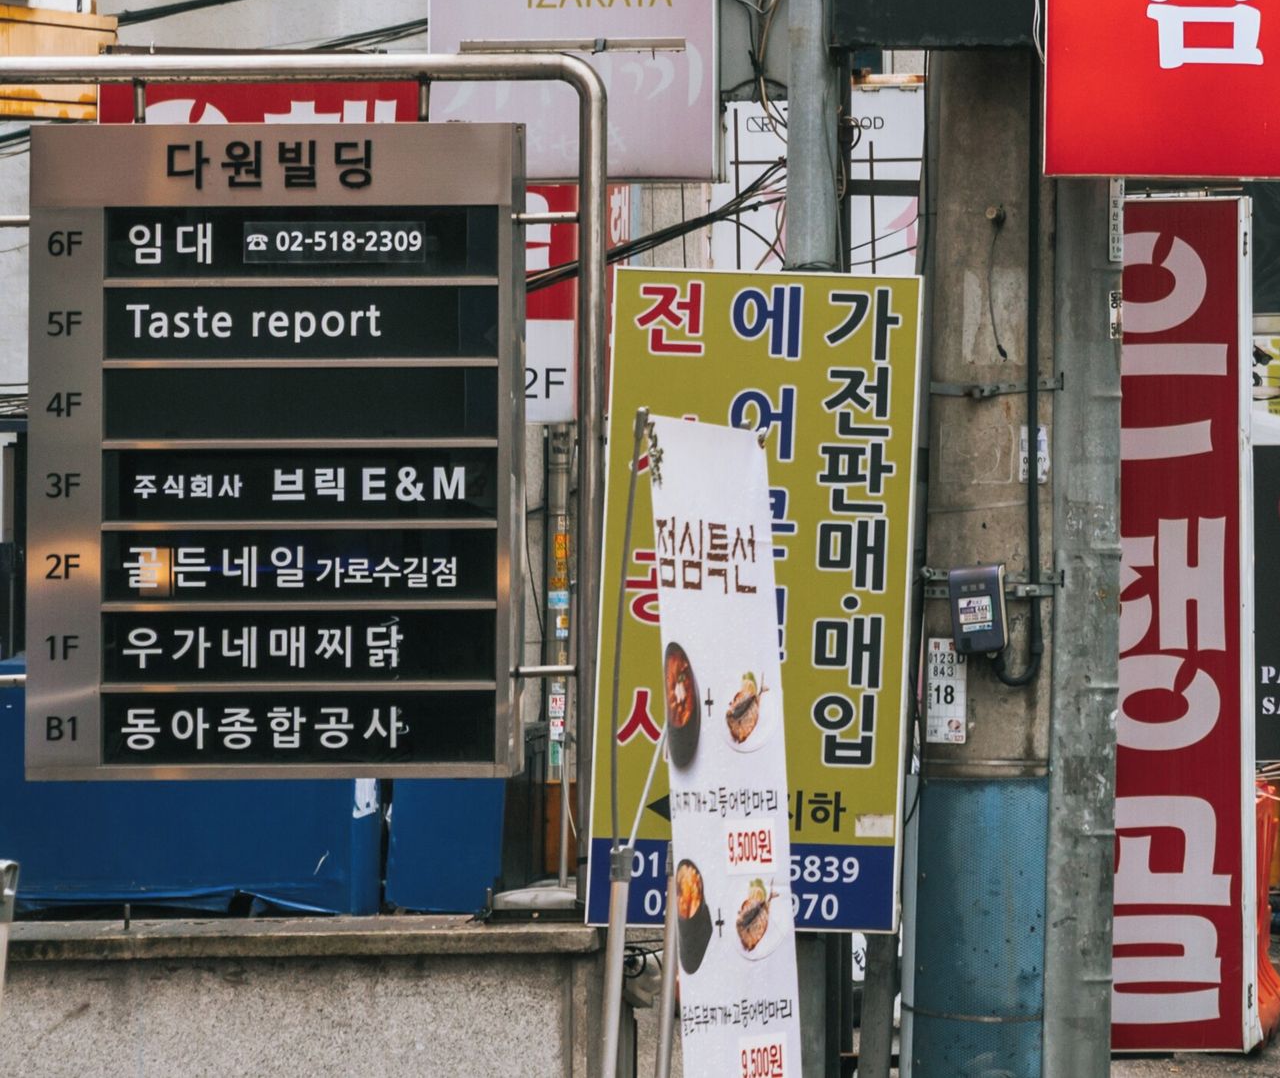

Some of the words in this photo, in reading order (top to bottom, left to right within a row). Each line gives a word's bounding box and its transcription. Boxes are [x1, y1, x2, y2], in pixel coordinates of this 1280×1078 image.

[166, 140, 374, 190] 다원빌딩
[47, 231, 84, 257] 6F
[128, 223, 213, 265] 임대
[275, 230, 423, 254] 02-518-2309
[46, 311, 82, 337] 5F
[126, 303, 233, 339] Taste
[251, 303, 382, 343] report
[46, 392, 82, 418] 4F
[45, 472, 81, 499] 3F
[133, 473, 242, 500] 주식회사
[272, 467, 346, 503] 브릭
[362, 466, 467, 501] E&M
[45, 554, 81, 580] 2F
[123, 545, 305, 589] 골든네일
[316, 556, 458, 589] 가로수길점
[656, 516, 757, 595] 점심특선
[45, 634, 80, 660] 1F
[122, 625, 404, 669] 우가네매찌닭
[934, 684, 955, 705] 18
[45, 715, 80, 741] B1
[121, 705, 405, 750] 동아종합공사
[727, 829, 774, 866] 9,500원
